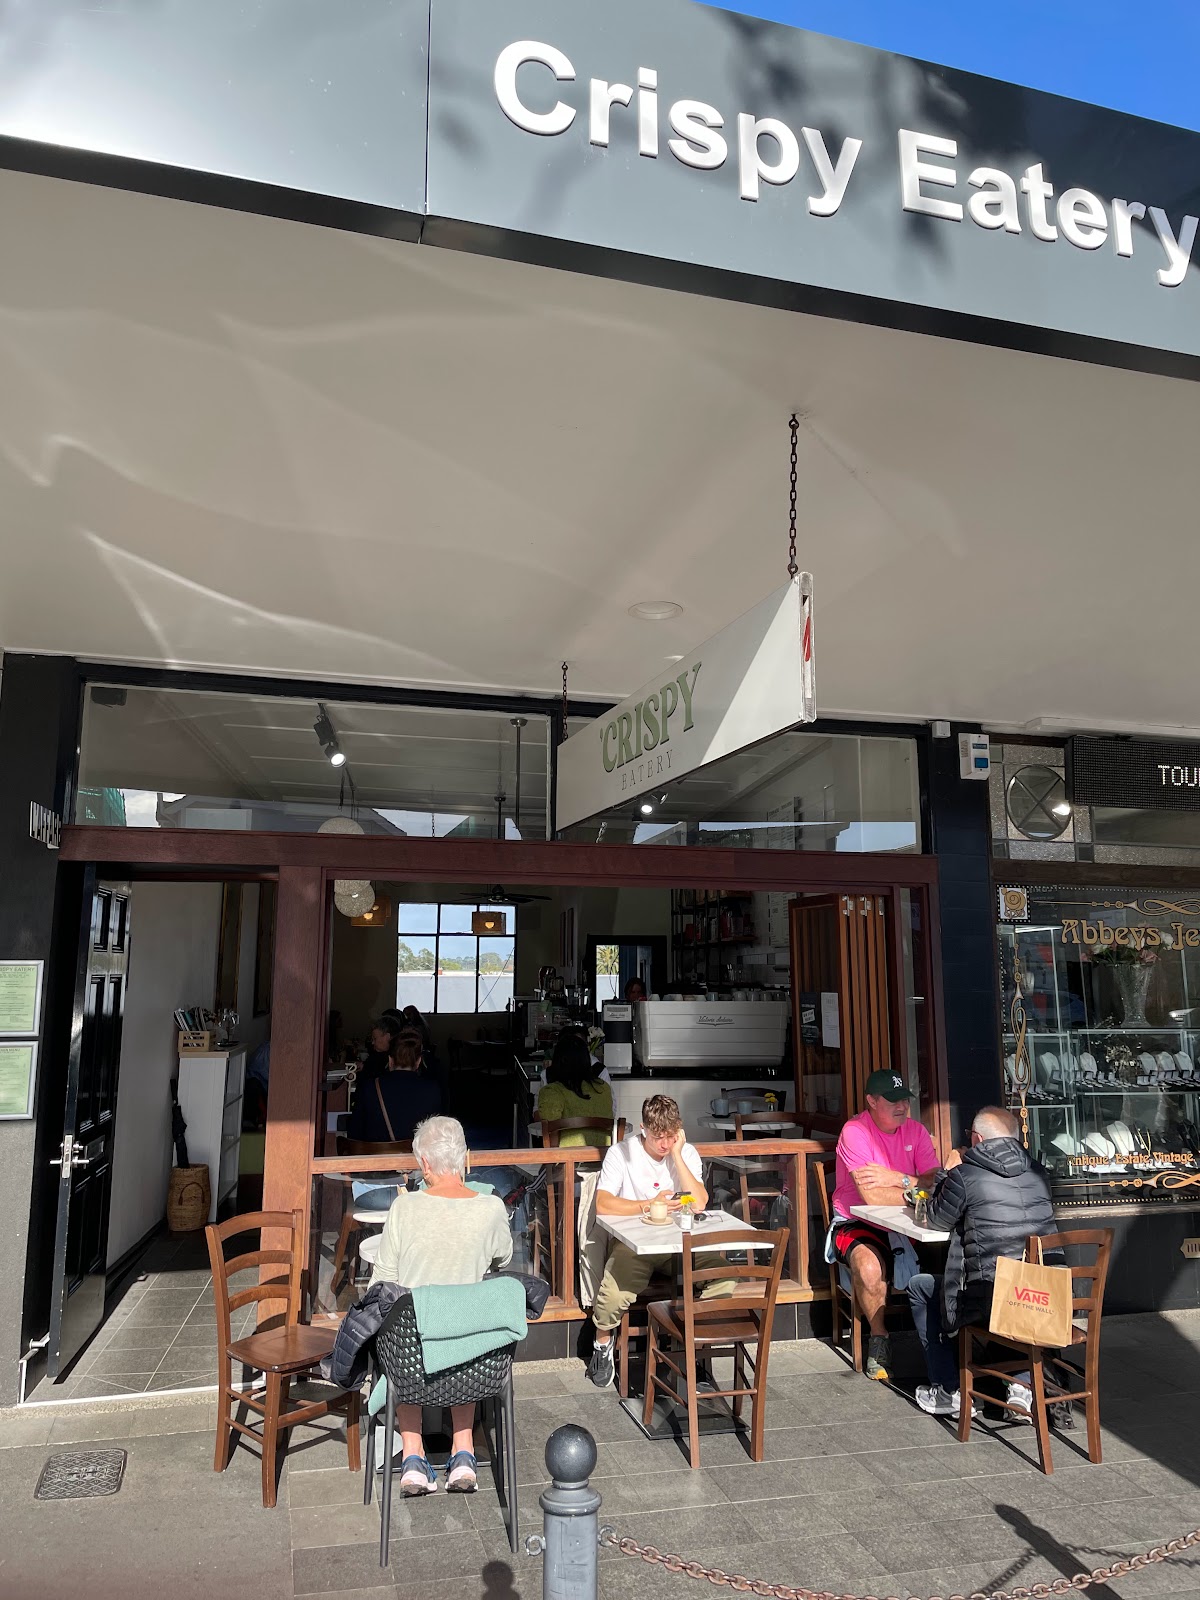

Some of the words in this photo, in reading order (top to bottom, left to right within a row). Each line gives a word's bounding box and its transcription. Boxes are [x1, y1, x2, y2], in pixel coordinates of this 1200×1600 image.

[494, 40, 863, 218] Crispy
[898, 128, 1199, 287] Eatery
[621, 749, 673, 791] EATERY
[1157, 764, 1200, 787] TOU
[1061, 919, 1161, 951] Abbeys
[1014, 1286, 1050, 1306] VANS
[1022, 1303, 1034, 1311] THE
